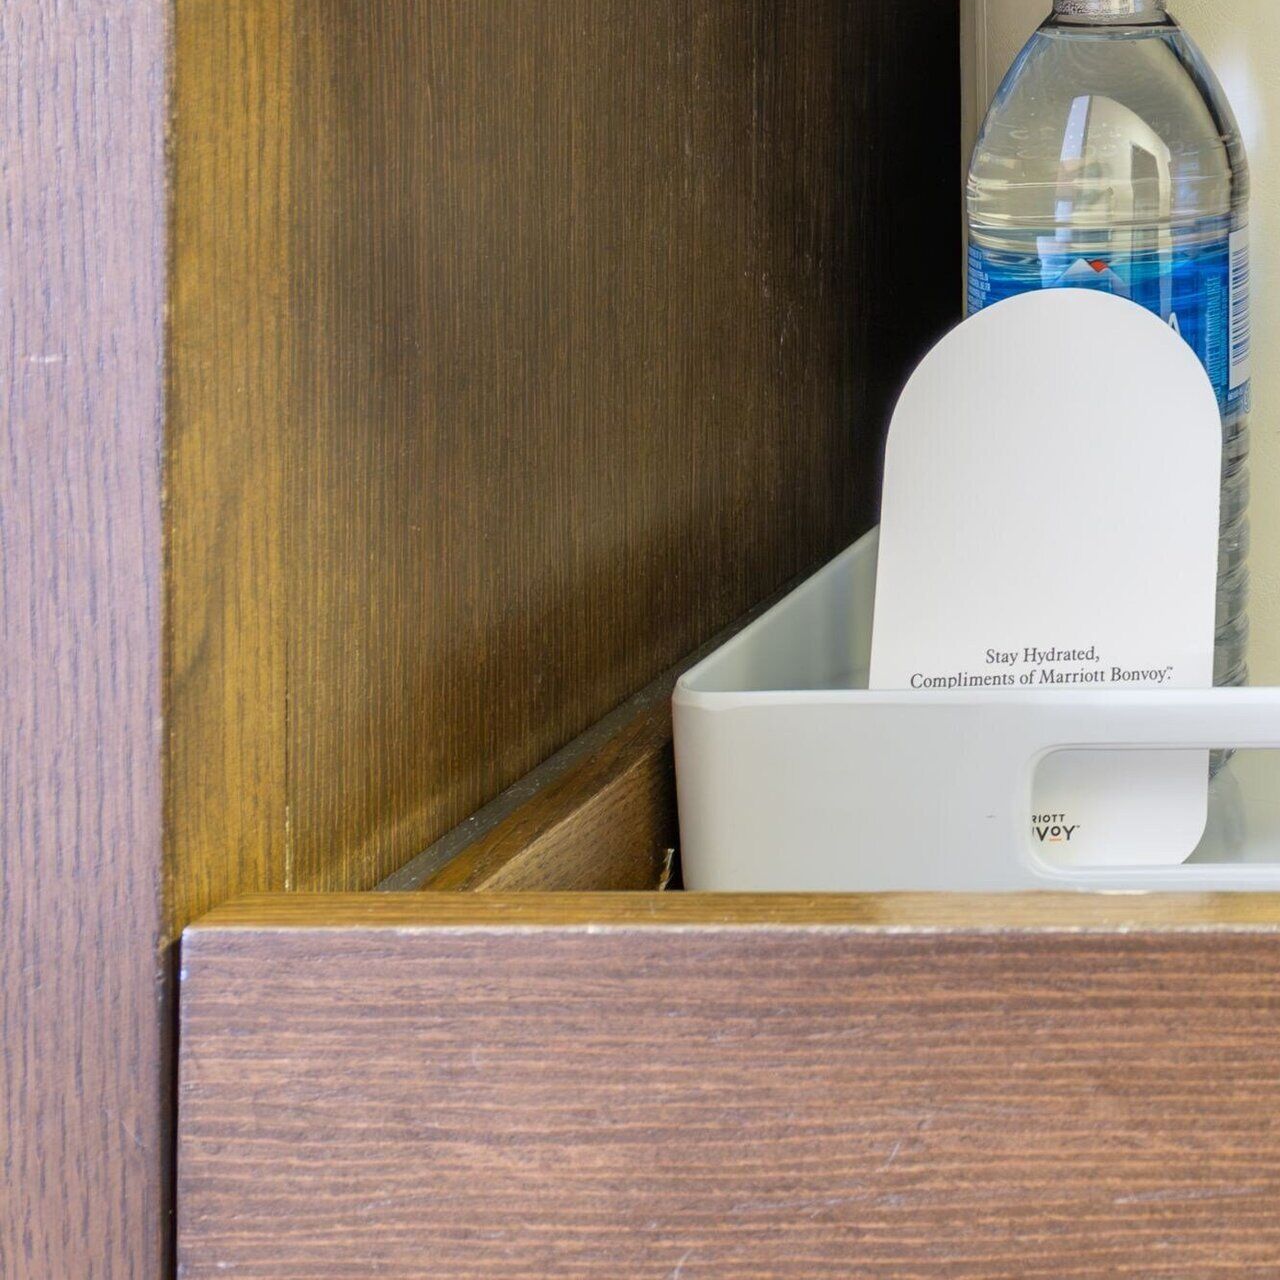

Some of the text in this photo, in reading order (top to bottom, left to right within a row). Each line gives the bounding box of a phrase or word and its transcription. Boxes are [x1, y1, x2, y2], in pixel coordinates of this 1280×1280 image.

[985, 646, 1100, 667] Stay Hydrated,
[910, 671, 1015, 689] Compliments
[1019, 669, 1036, 685] of
[1038, 668, 1105, 685] Marriott
